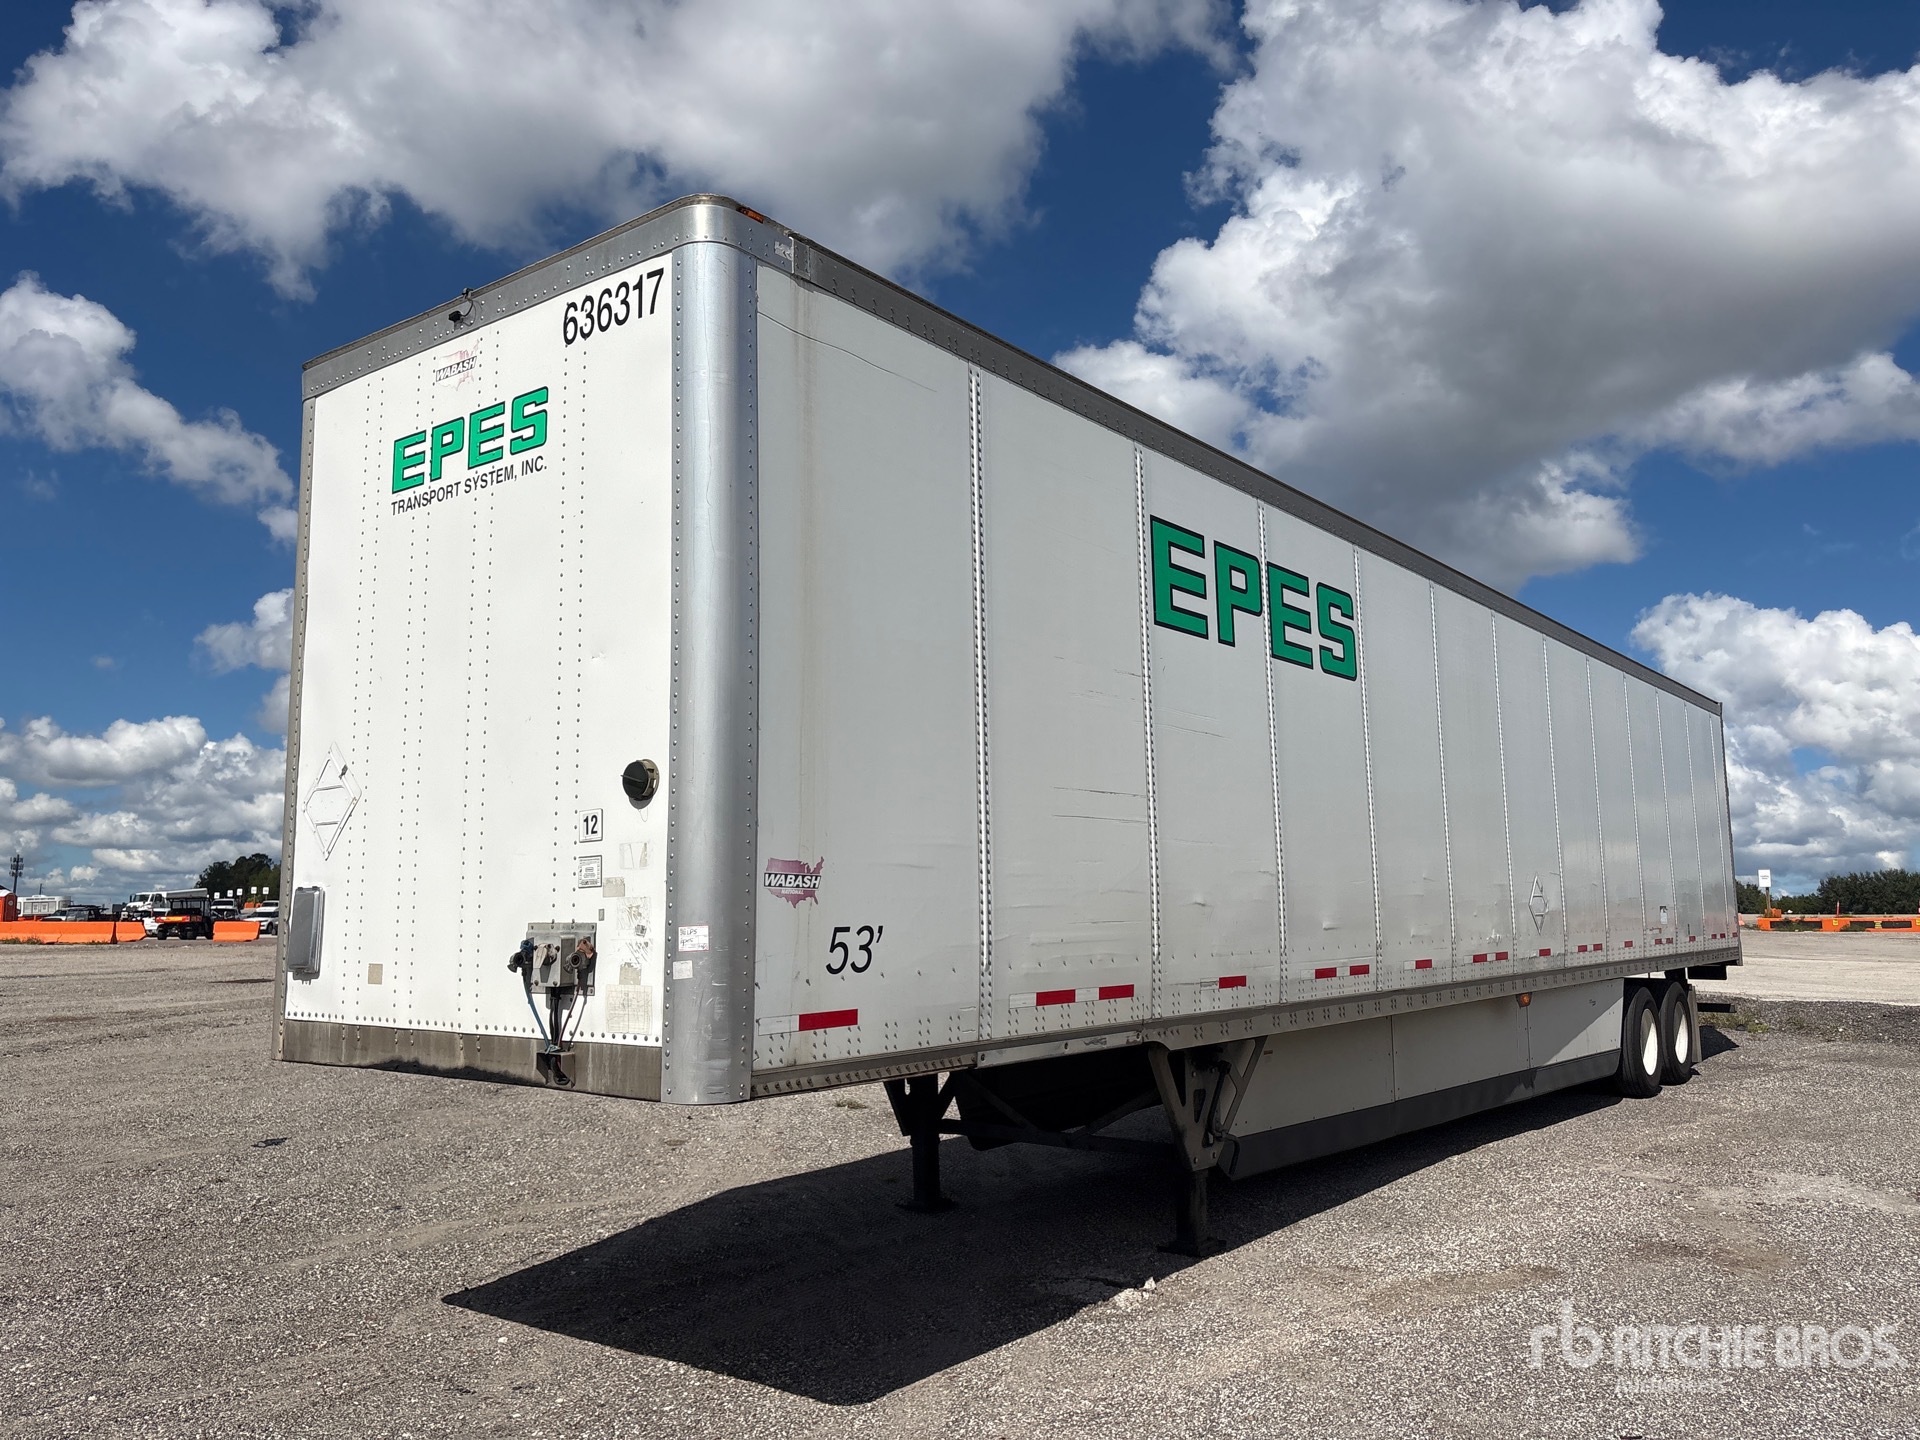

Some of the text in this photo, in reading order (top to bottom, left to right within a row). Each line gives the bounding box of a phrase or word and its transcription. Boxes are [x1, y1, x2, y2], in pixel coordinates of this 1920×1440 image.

[563, 267, 664, 345] 636317
[436, 356, 477, 382] WABASH
[392, 386, 549, 494] EPES
[391, 455, 548, 516] TRANSPORT SYSTEM, INC.
[1150, 514, 1358, 682] EPES
[583, 814, 598, 836] 12
[764, 873, 821, 889] WABASH
[826, 925, 883, 975] 53'
